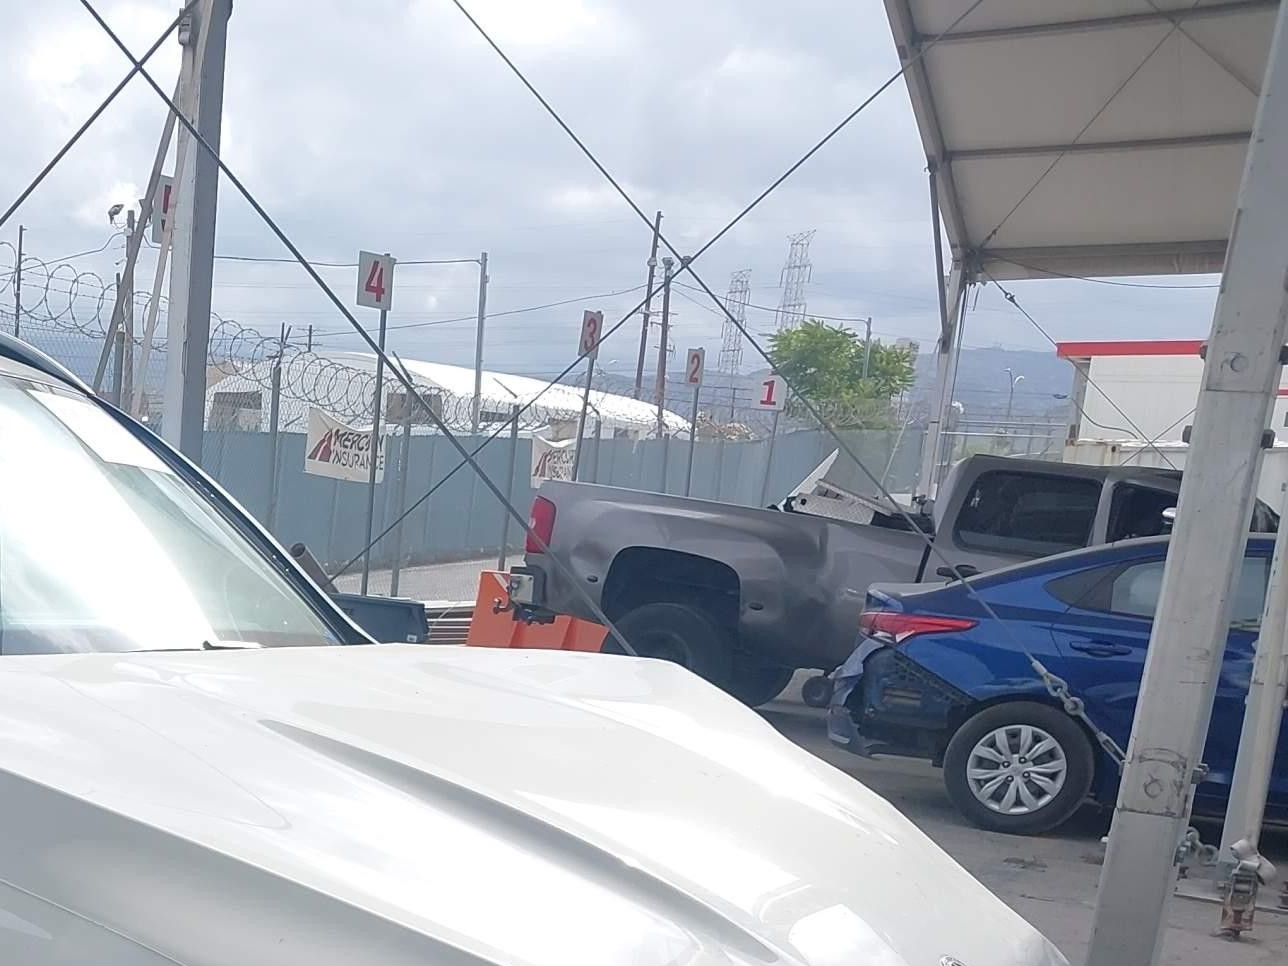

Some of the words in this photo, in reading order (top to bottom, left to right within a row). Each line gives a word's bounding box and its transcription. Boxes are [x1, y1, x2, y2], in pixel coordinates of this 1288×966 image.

[364, 260, 386, 303] 4
[584, 317, 598, 352] 3
[688, 352, 701, 383] 2
[759, 379, 777, 406] 1
[333, 428, 384, 453] MERCUY
[332, 448, 385, 471] INSURANE
